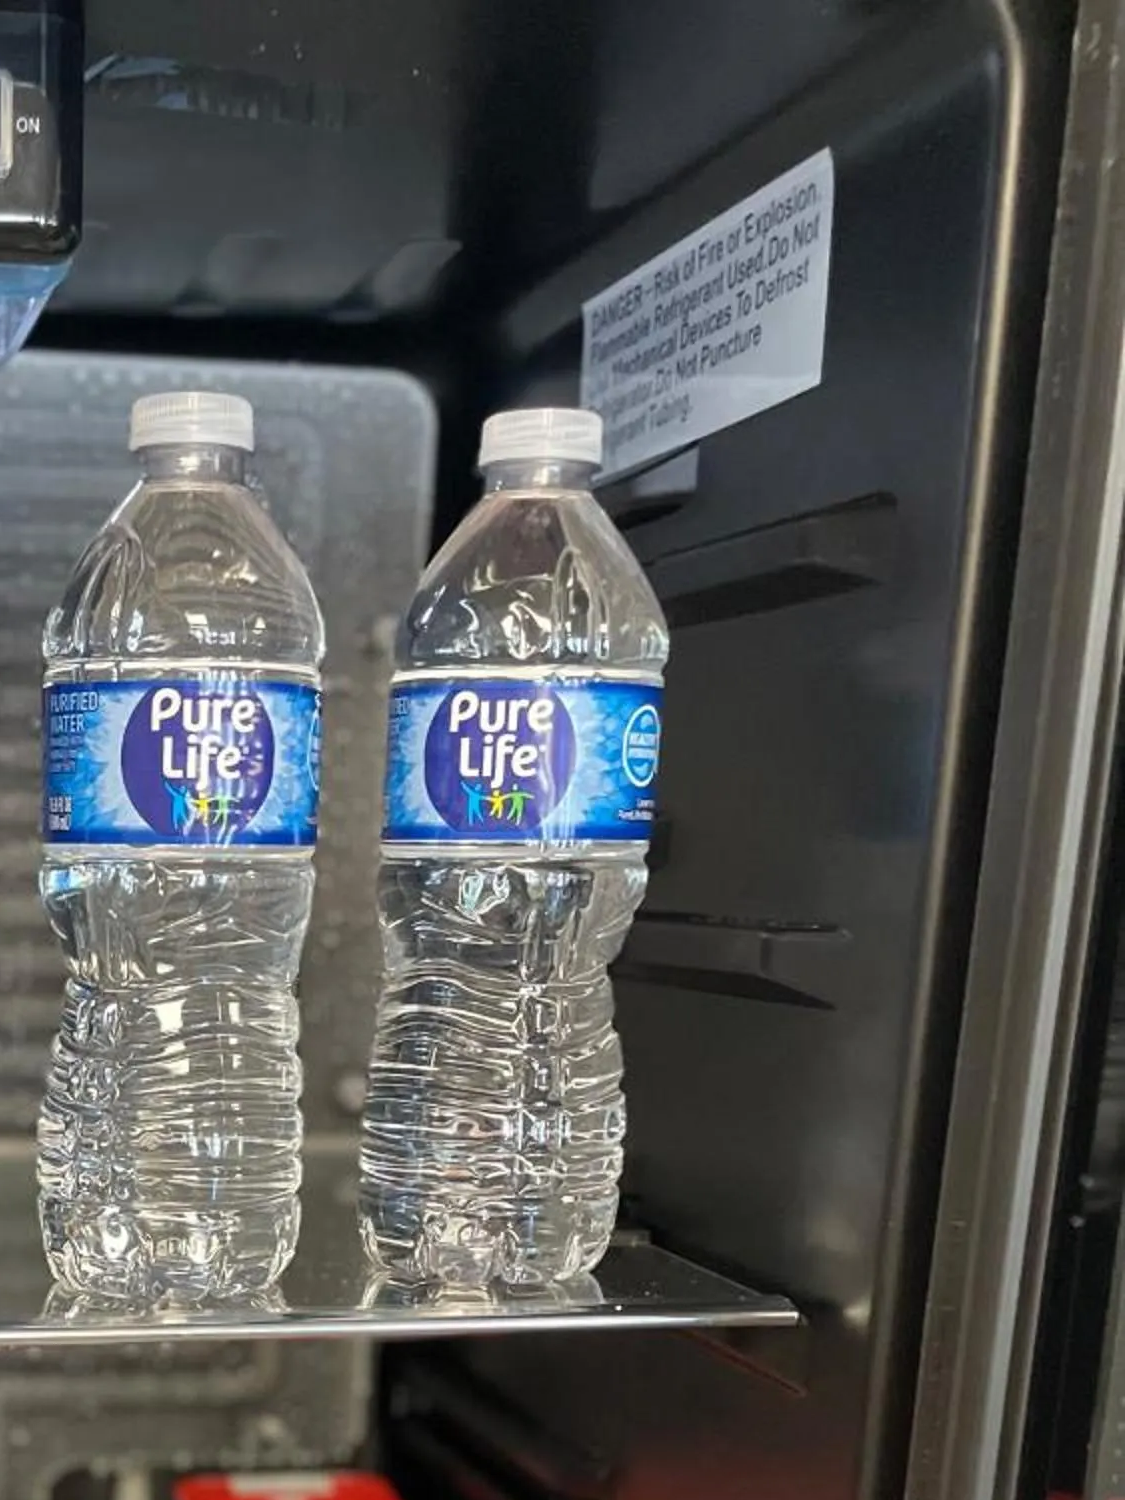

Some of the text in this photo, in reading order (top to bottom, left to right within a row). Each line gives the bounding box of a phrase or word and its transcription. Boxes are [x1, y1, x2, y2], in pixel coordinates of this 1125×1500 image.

[16, 116, 40, 134] ON
[592, 284, 643, 338] DANGER
[654, 261, 679, 302] Risk
[683, 248, 696, 282] of
[698, 239, 723, 271] Fire
[727, 227, 741, 254] or
[654, 272, 724, 332] Refrigerant
[793, 212, 820, 253] Not
[680, 304, 732, 350] Devices
[736, 289, 753, 319] To
[755, 255, 810, 311] Defrost
[676, 353, 698, 381] Not
[700, 323, 763, 371] Puncture
[150, 687, 256, 733] Pure
[448, 690, 555, 733] Pure
[162, 735, 242, 791] Life
[458, 733, 538, 789] Life
